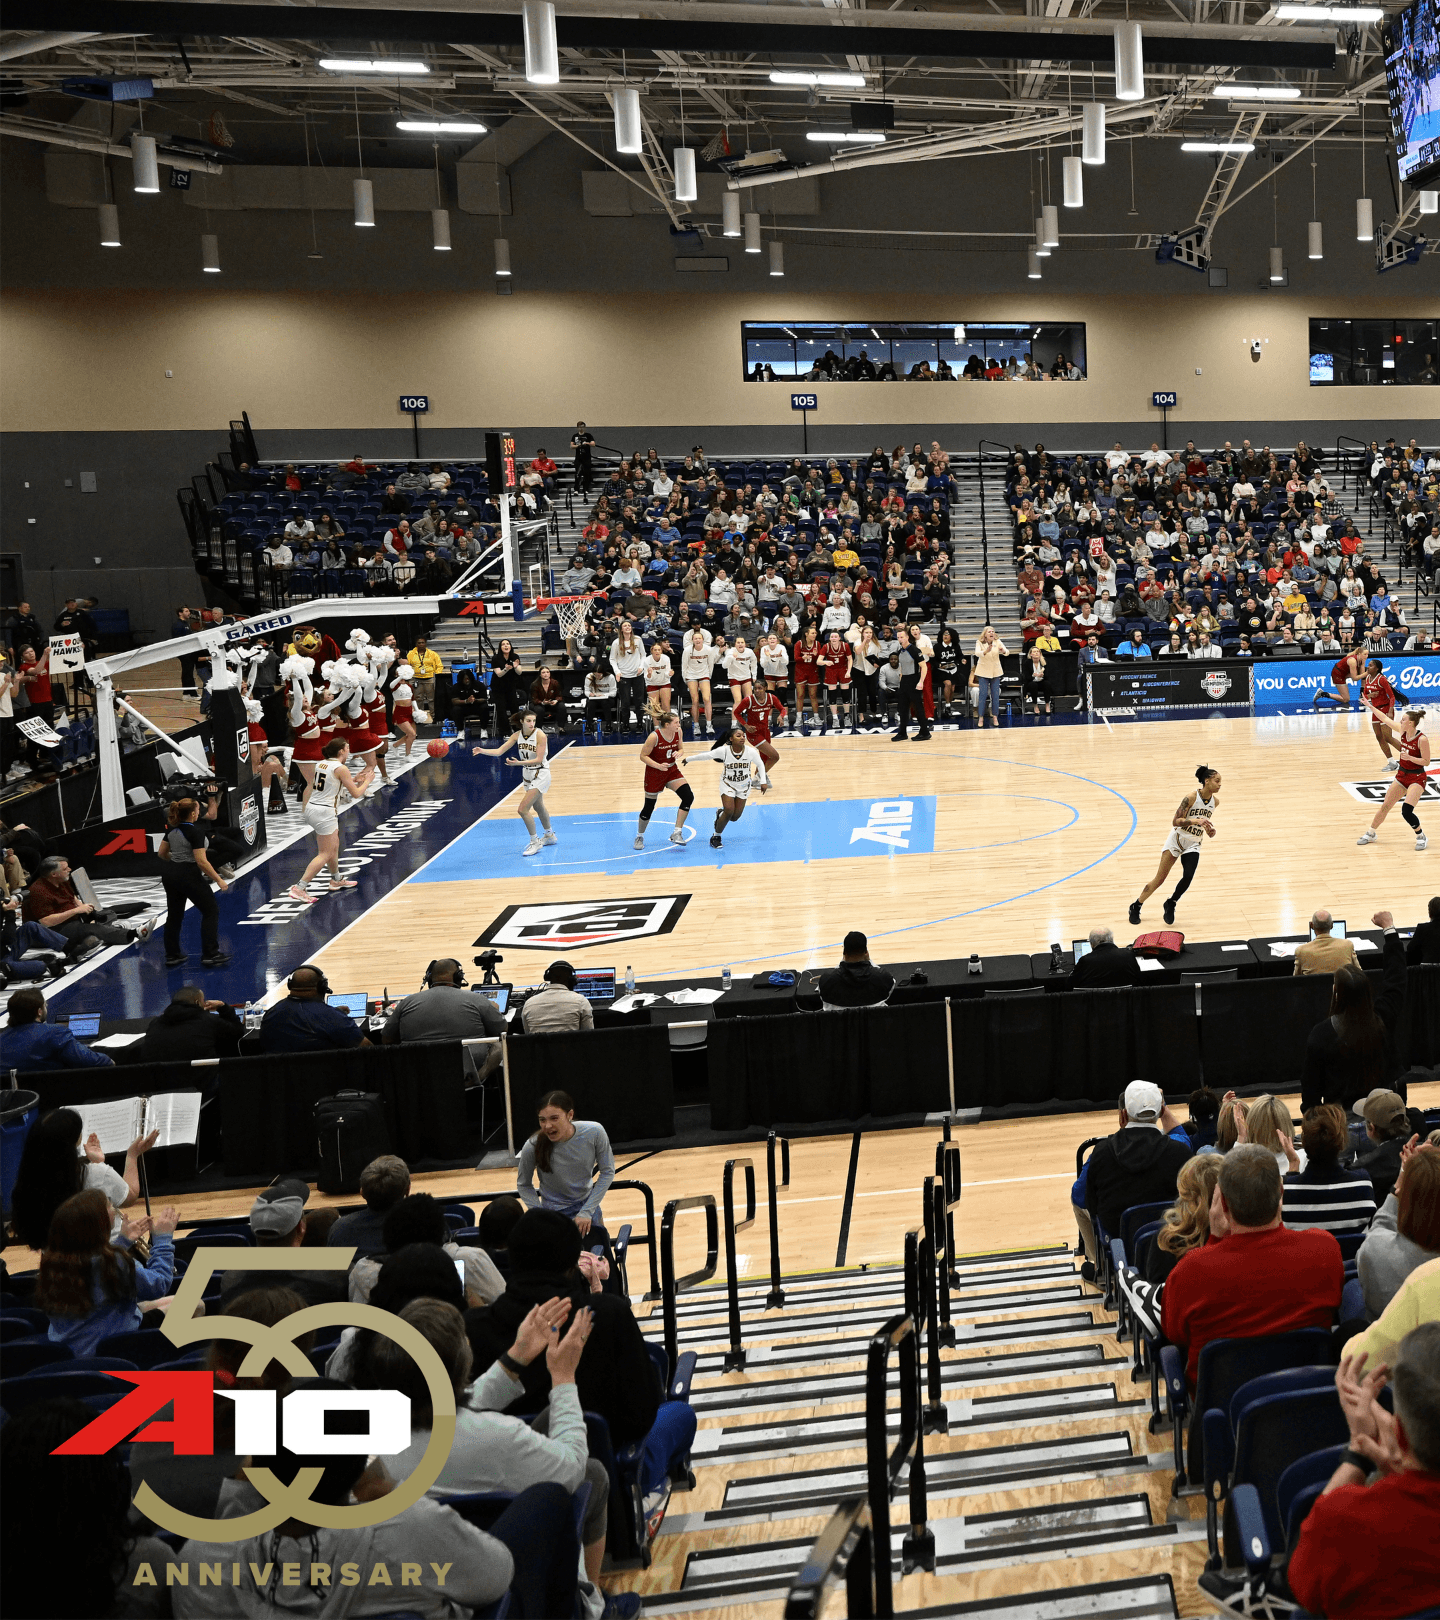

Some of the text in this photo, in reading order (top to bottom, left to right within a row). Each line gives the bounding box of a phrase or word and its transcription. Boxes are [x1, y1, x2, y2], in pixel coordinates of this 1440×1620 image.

[402, 398, 426, 408] 106
[793, 396, 815, 406] 105
[1154, 394, 1175, 404] 104
[457, 600, 514, 616] A10
[226, 614, 292, 641] GARED
[50, 640, 64, 648] WE
[53, 646, 82, 656] HAWKS
[1256, 677, 1284, 690] YOU
[1287, 676, 1327, 689] CAN'T
[727, 774, 749, 782] MASON
[733, 769, 744, 777] 13
[849, 800, 914, 849] A10
